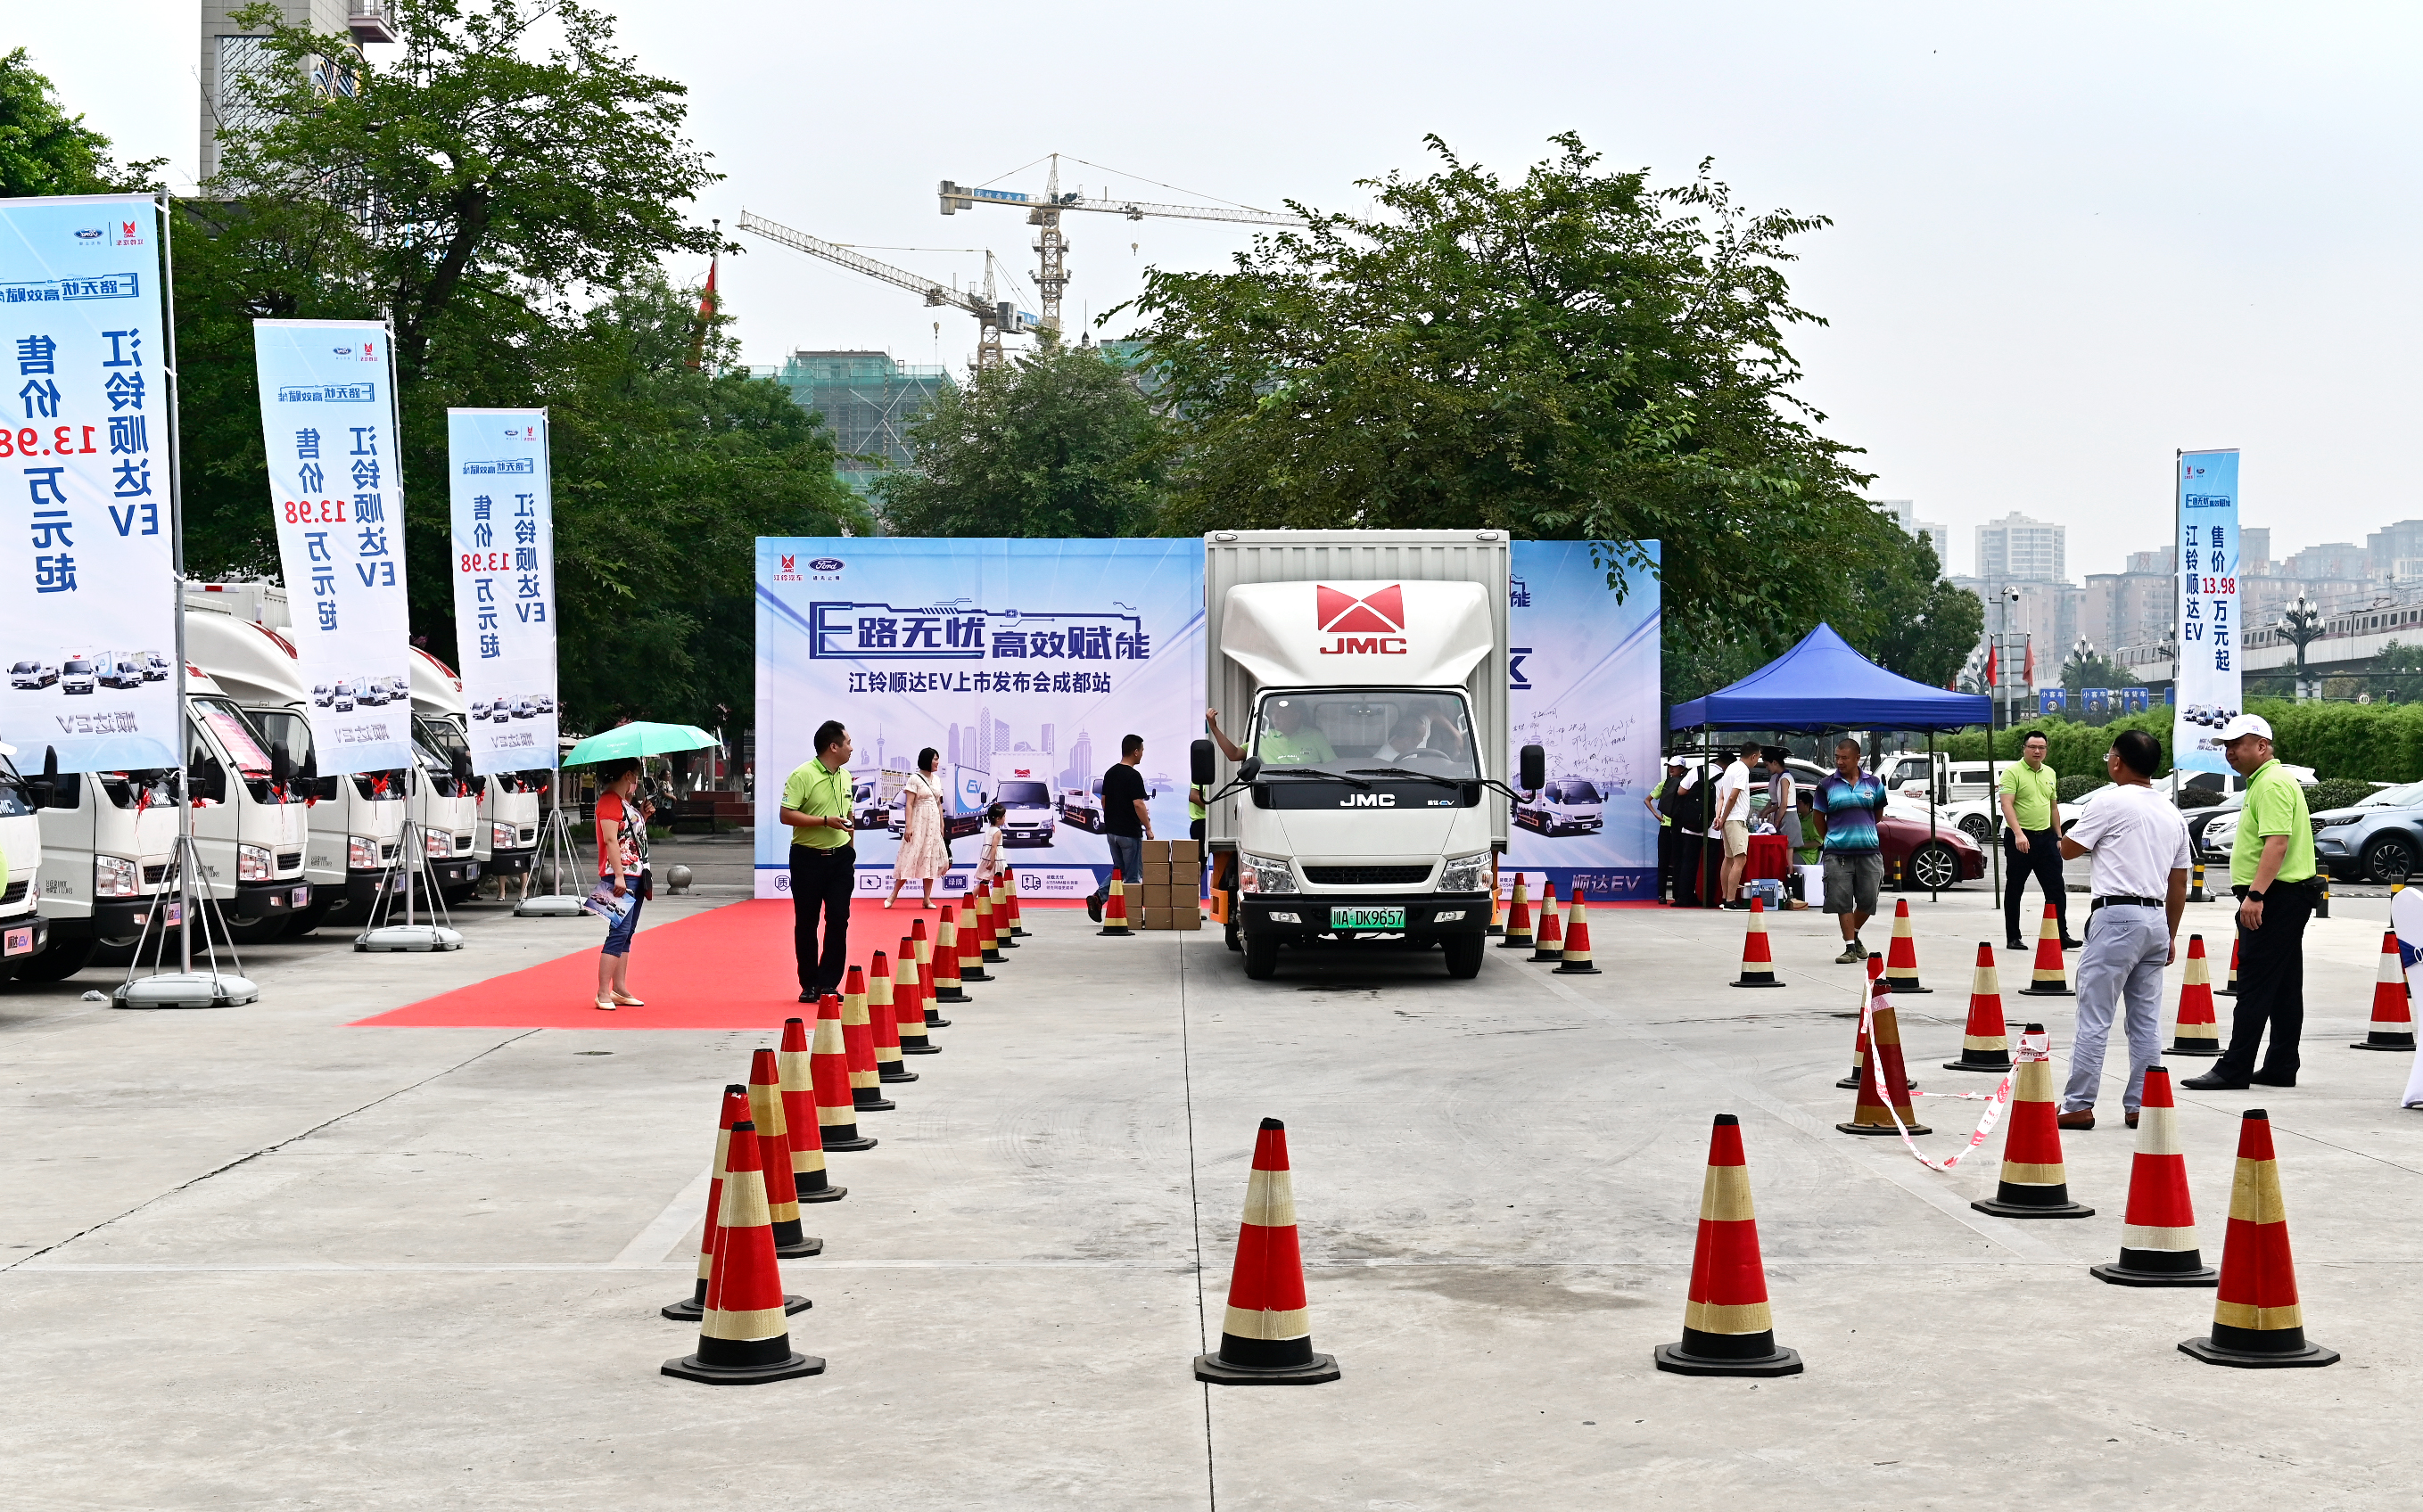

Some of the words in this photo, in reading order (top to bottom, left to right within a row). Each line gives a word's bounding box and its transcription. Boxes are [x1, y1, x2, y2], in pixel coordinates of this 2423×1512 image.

[2185, 524, 2204, 641] 江铃顺达EV
[1320, 637, 1407, 654] JMC
[848, 671, 1111, 694] 江铃顺达EV上市发布会成都站
[966, 778, 983, 794] EV
[1339, 793, 1396, 807] JMC
[1570, 874, 1641, 893] 顺达EV
